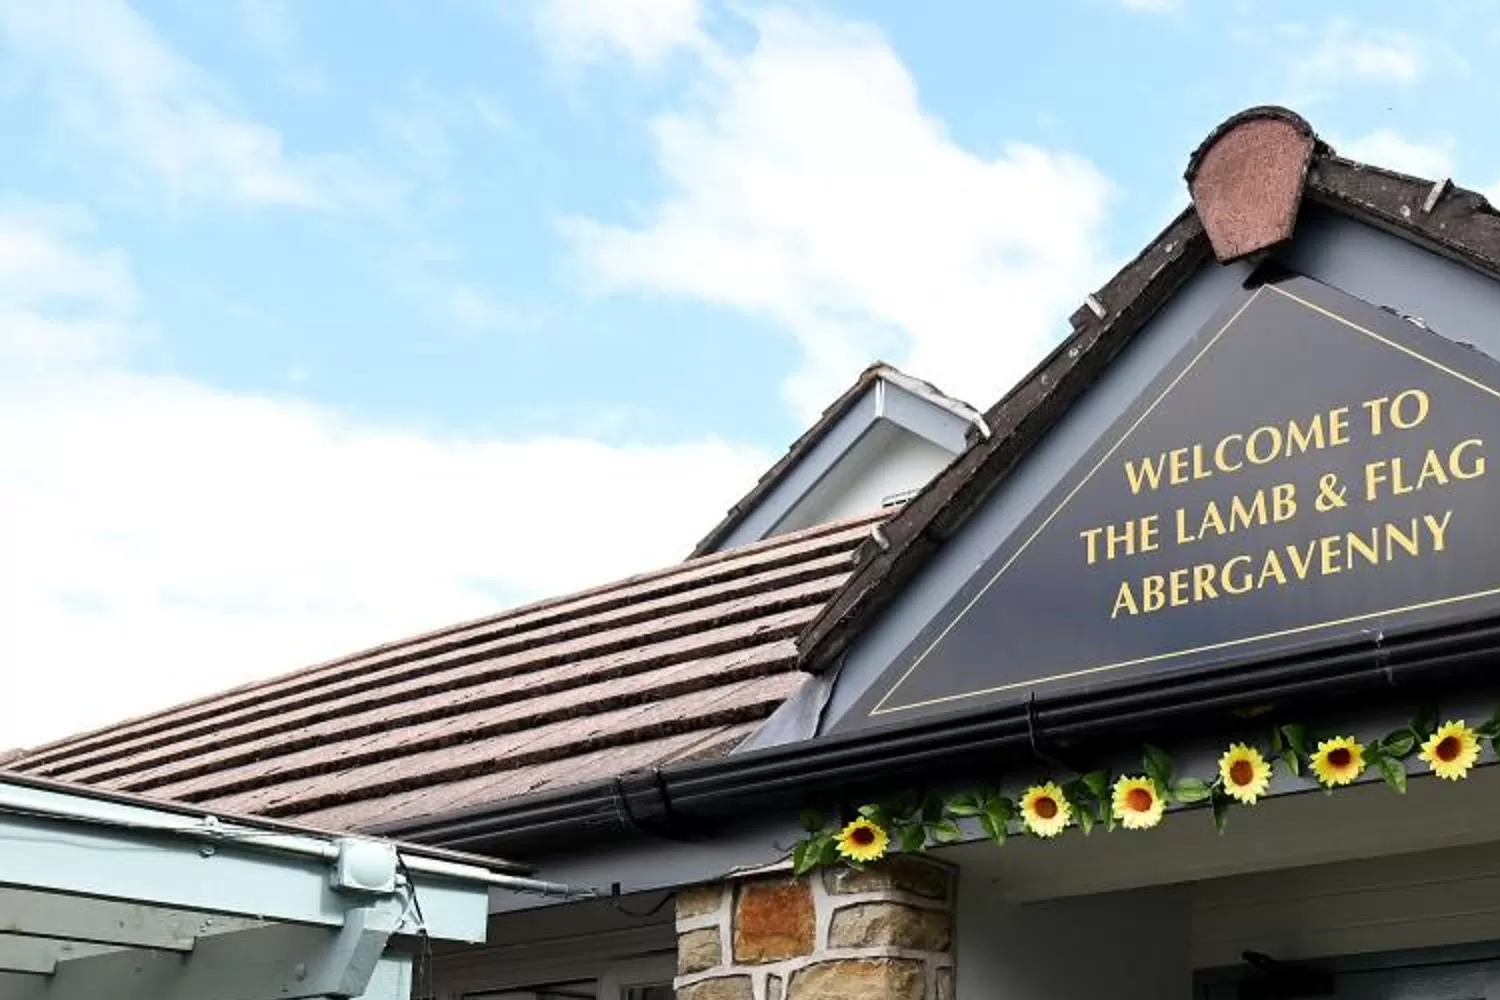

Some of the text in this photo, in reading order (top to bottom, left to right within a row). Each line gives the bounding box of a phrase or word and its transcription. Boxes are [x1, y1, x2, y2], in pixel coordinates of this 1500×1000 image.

[1124, 389, 1430, 494] WELCOME TO
[1080, 439, 1486, 565] THE LAMB & FLAG
[1110, 511, 1453, 619] ABERGAVENNY
